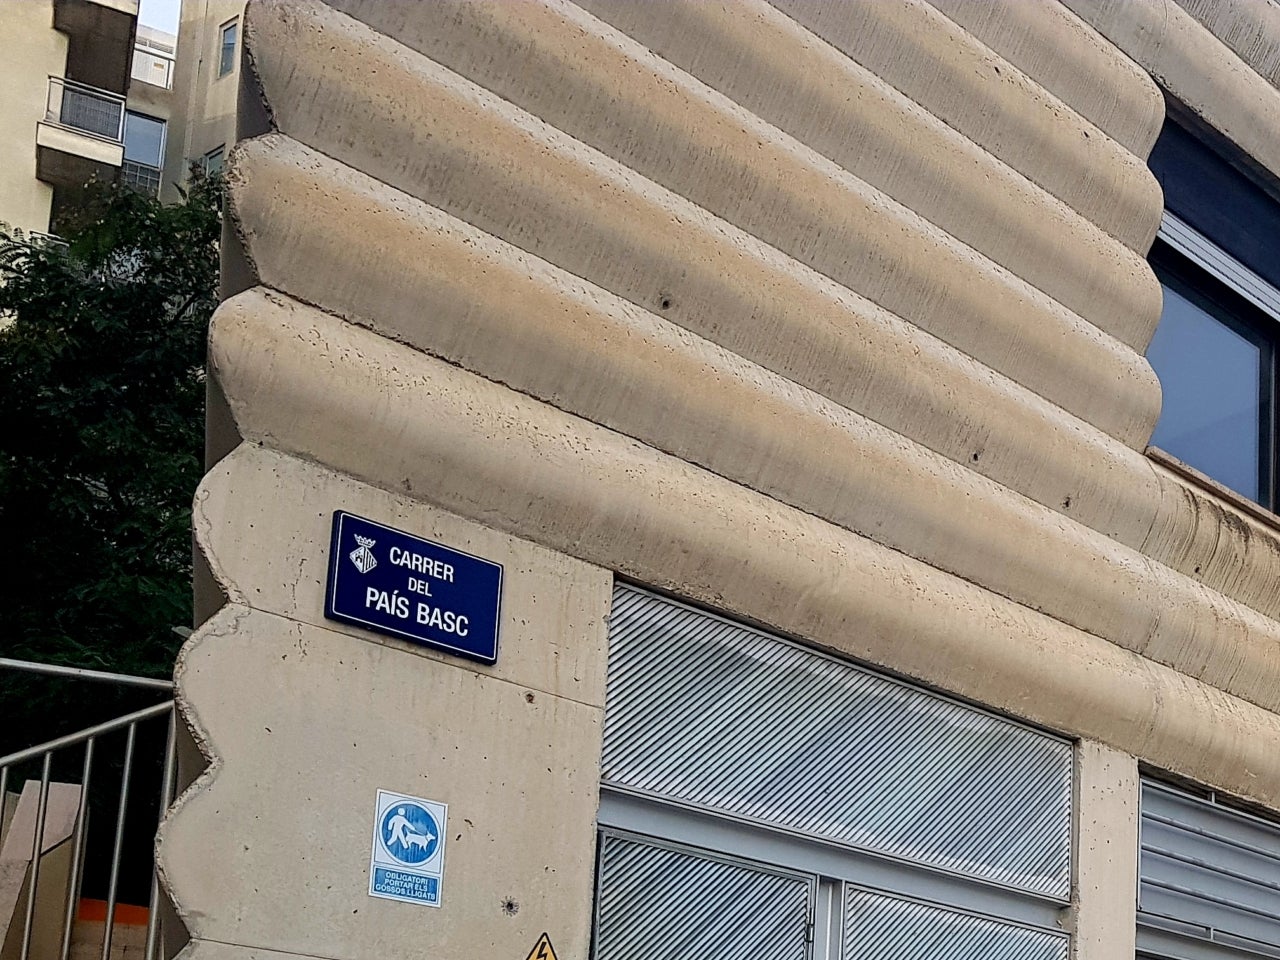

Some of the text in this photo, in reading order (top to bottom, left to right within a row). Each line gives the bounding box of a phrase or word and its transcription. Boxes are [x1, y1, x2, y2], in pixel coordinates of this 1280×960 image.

[389, 546, 454, 583] CARRER
[408, 577, 432, 597] DEL
[365, 587, 469, 636] PAÍS BASC
[384, 878, 428, 892] PORTAR ELS
[385, 871, 428, 885] OBLIGATORI
[375, 883, 436, 900] GOSSOS LLIGATS
